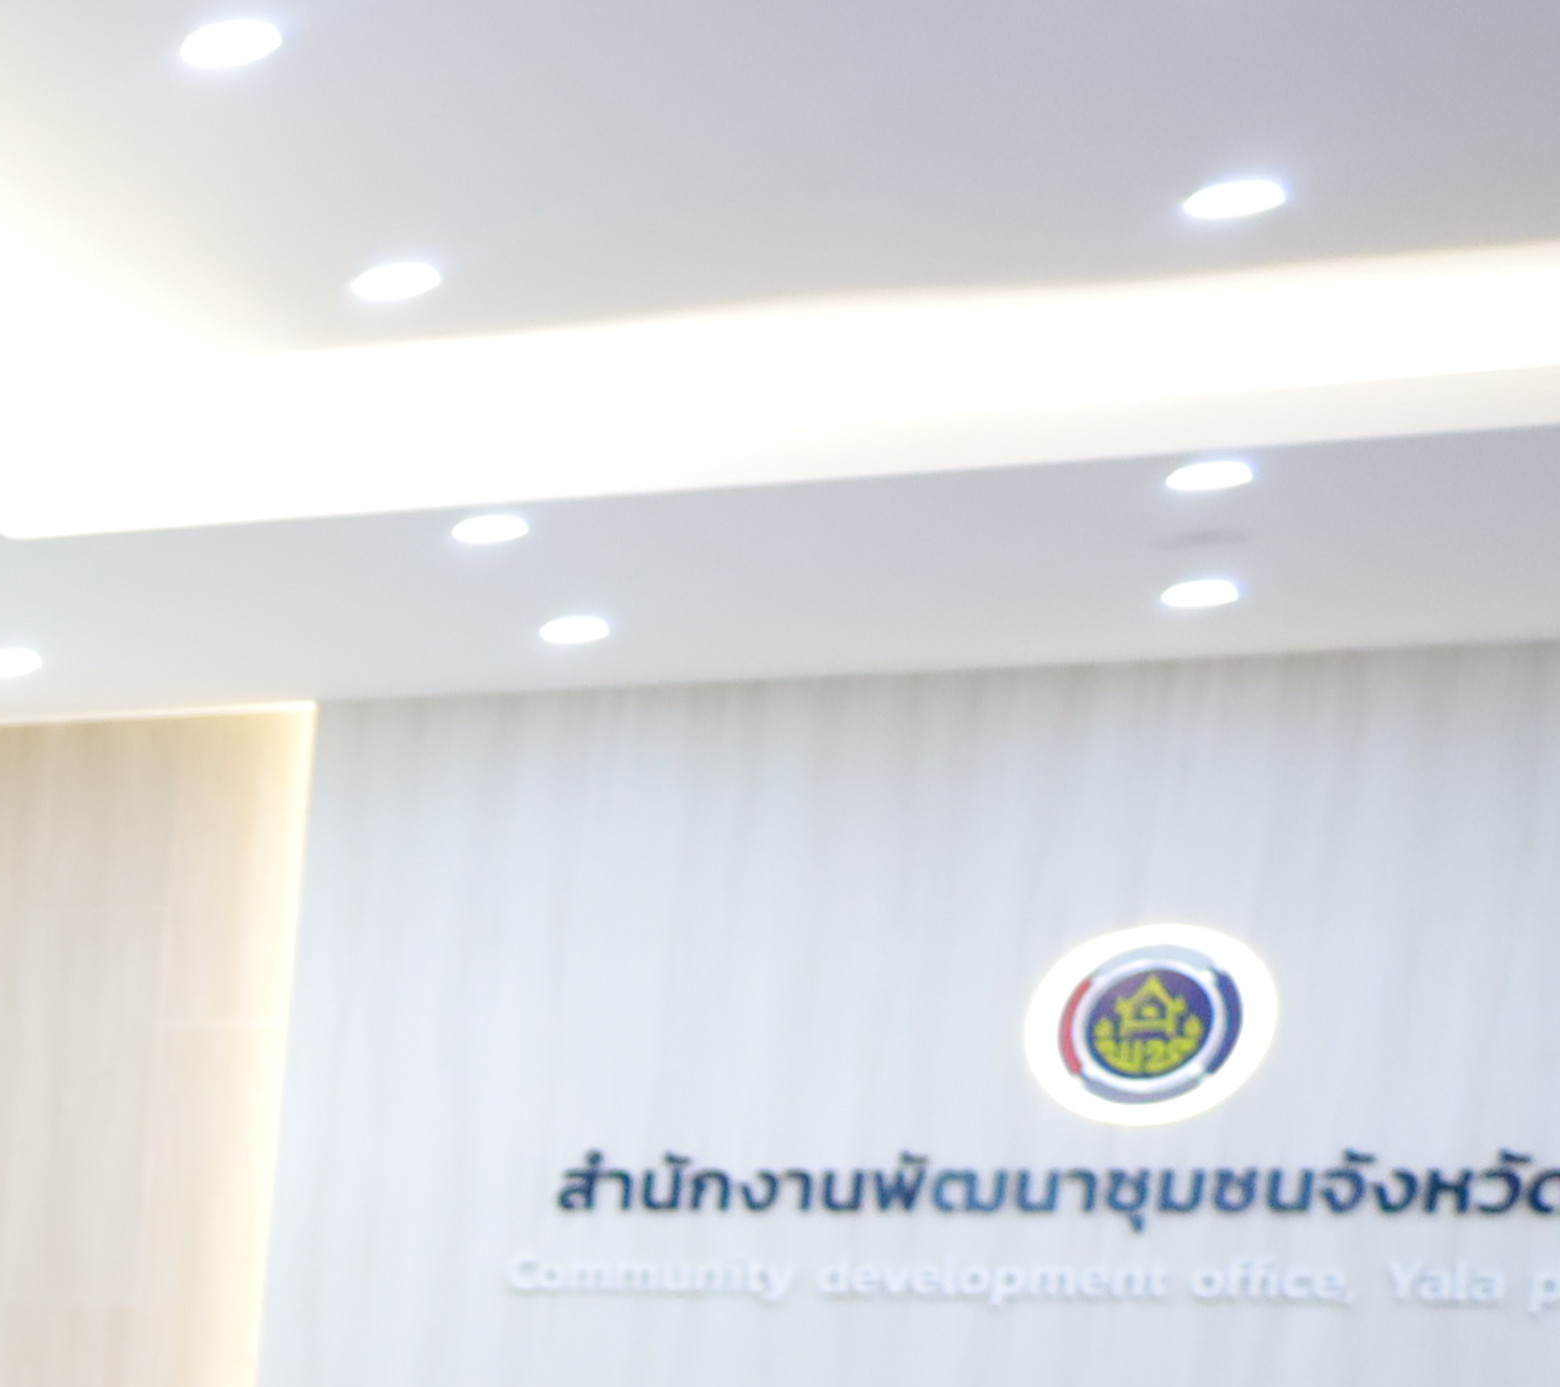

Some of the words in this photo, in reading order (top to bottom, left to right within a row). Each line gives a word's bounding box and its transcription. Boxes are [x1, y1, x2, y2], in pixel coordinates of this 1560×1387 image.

[510, 1256, 793, 1301] Community
[822, 1258, 1167, 1306] development
[1387, 1261, 1506, 1301] Yala
